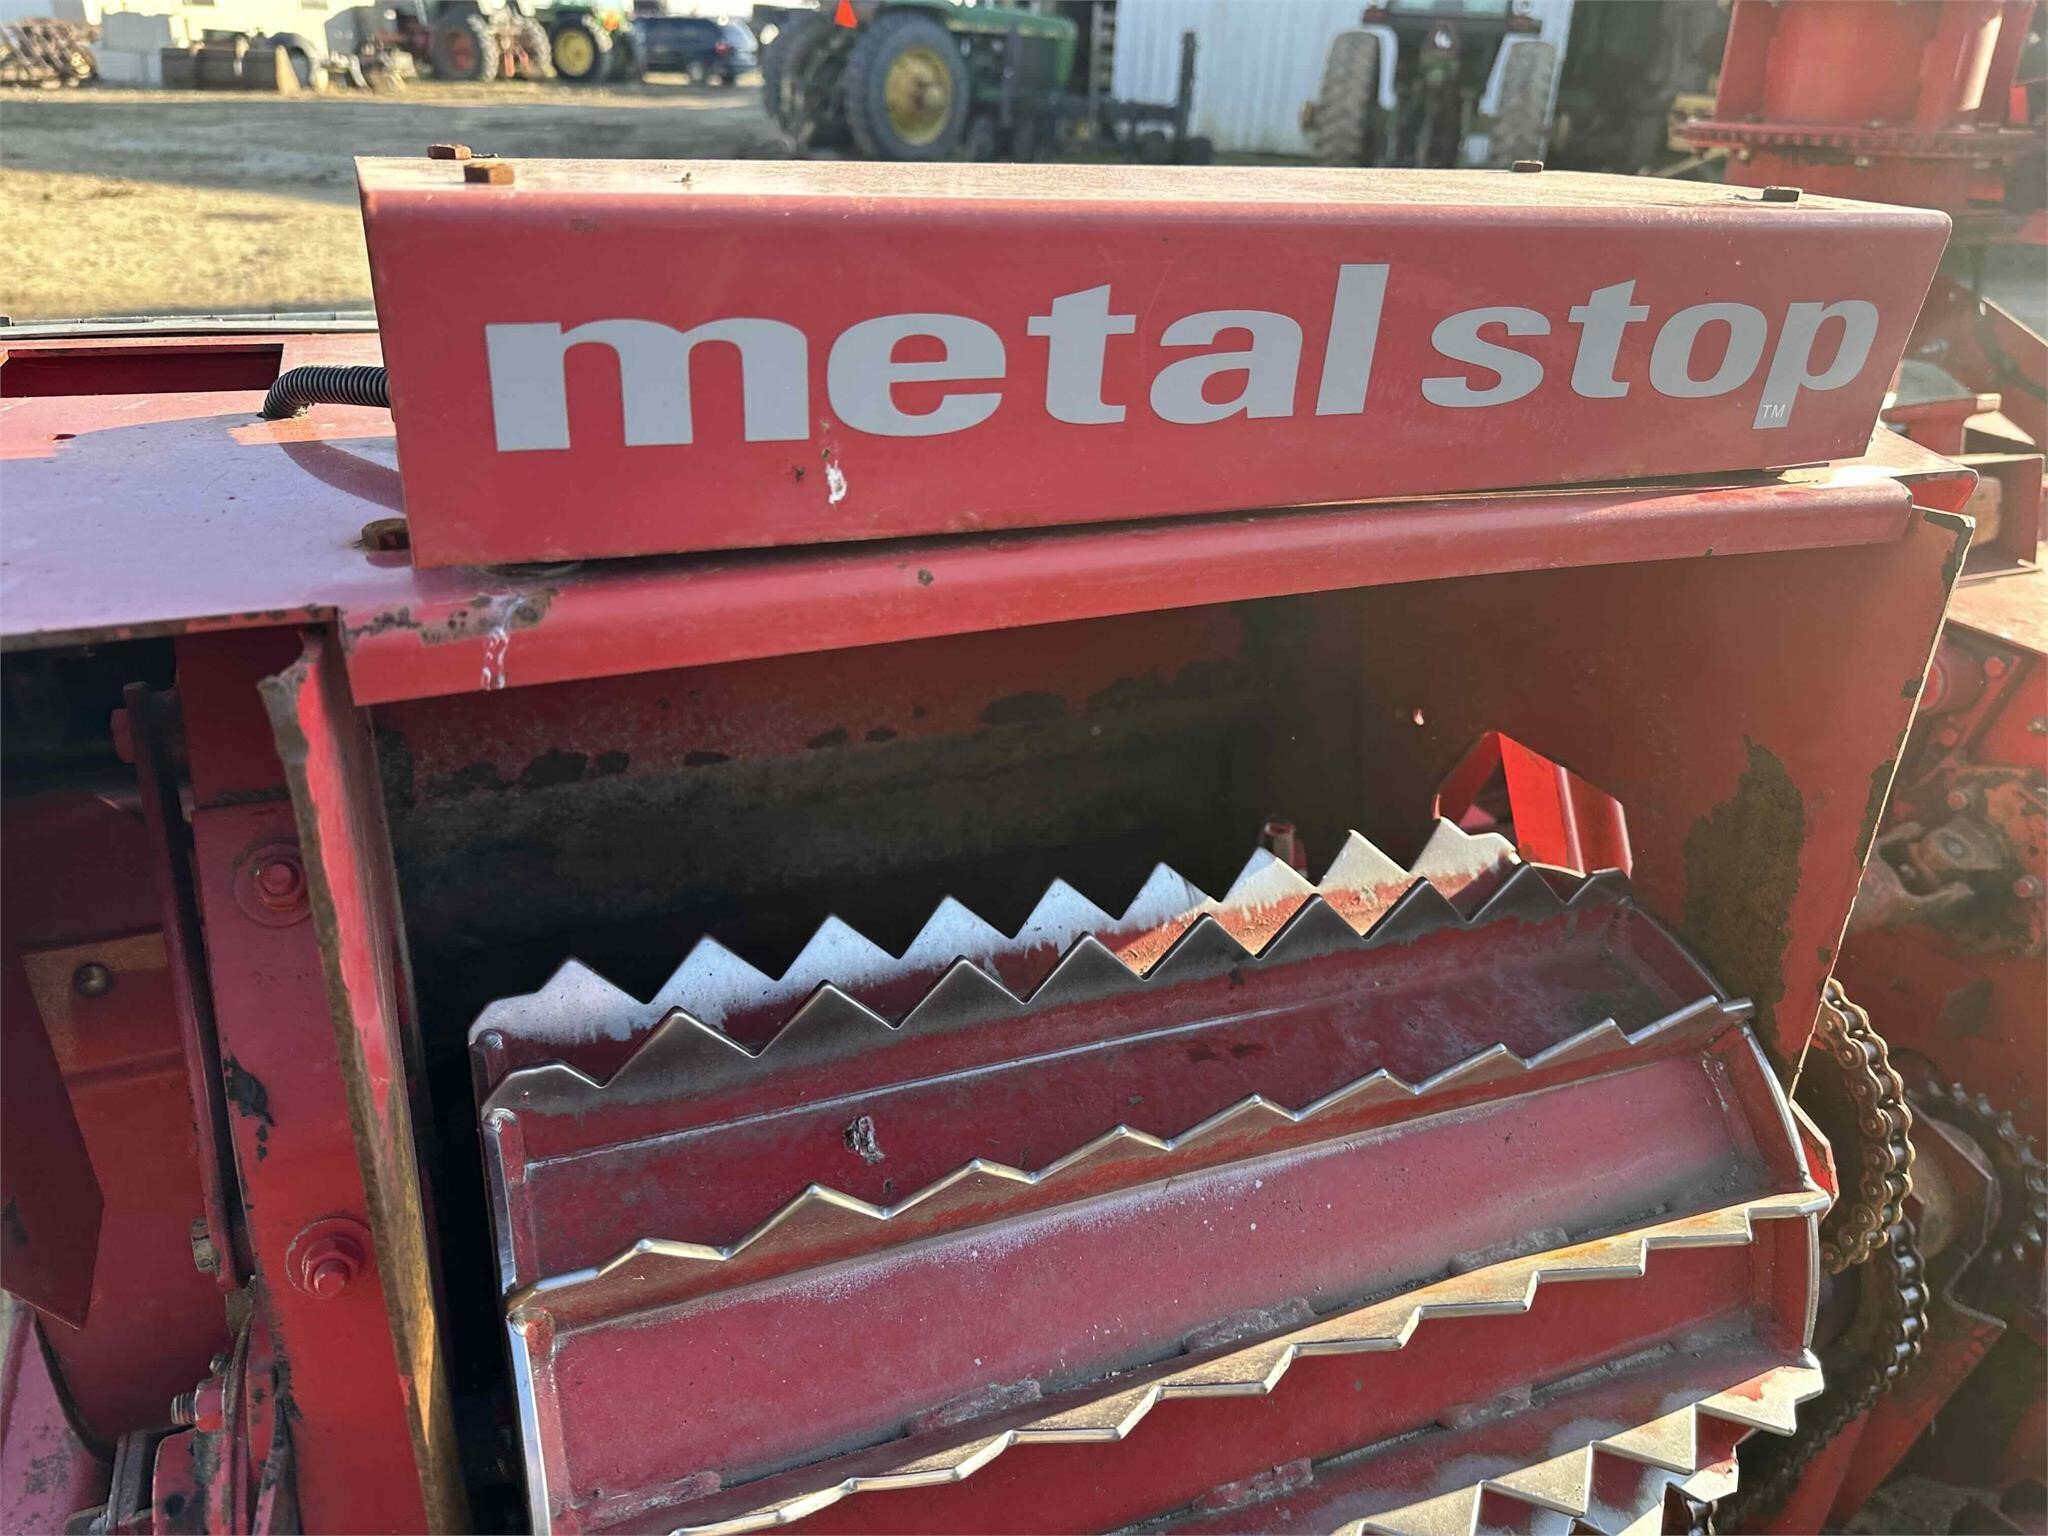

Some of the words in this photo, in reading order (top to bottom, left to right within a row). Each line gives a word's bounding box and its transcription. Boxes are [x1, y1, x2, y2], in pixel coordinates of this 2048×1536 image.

[485, 263, 1391, 452] metal
[1421, 279, 1880, 430] stop
[1762, 403, 1786, 419] TM
